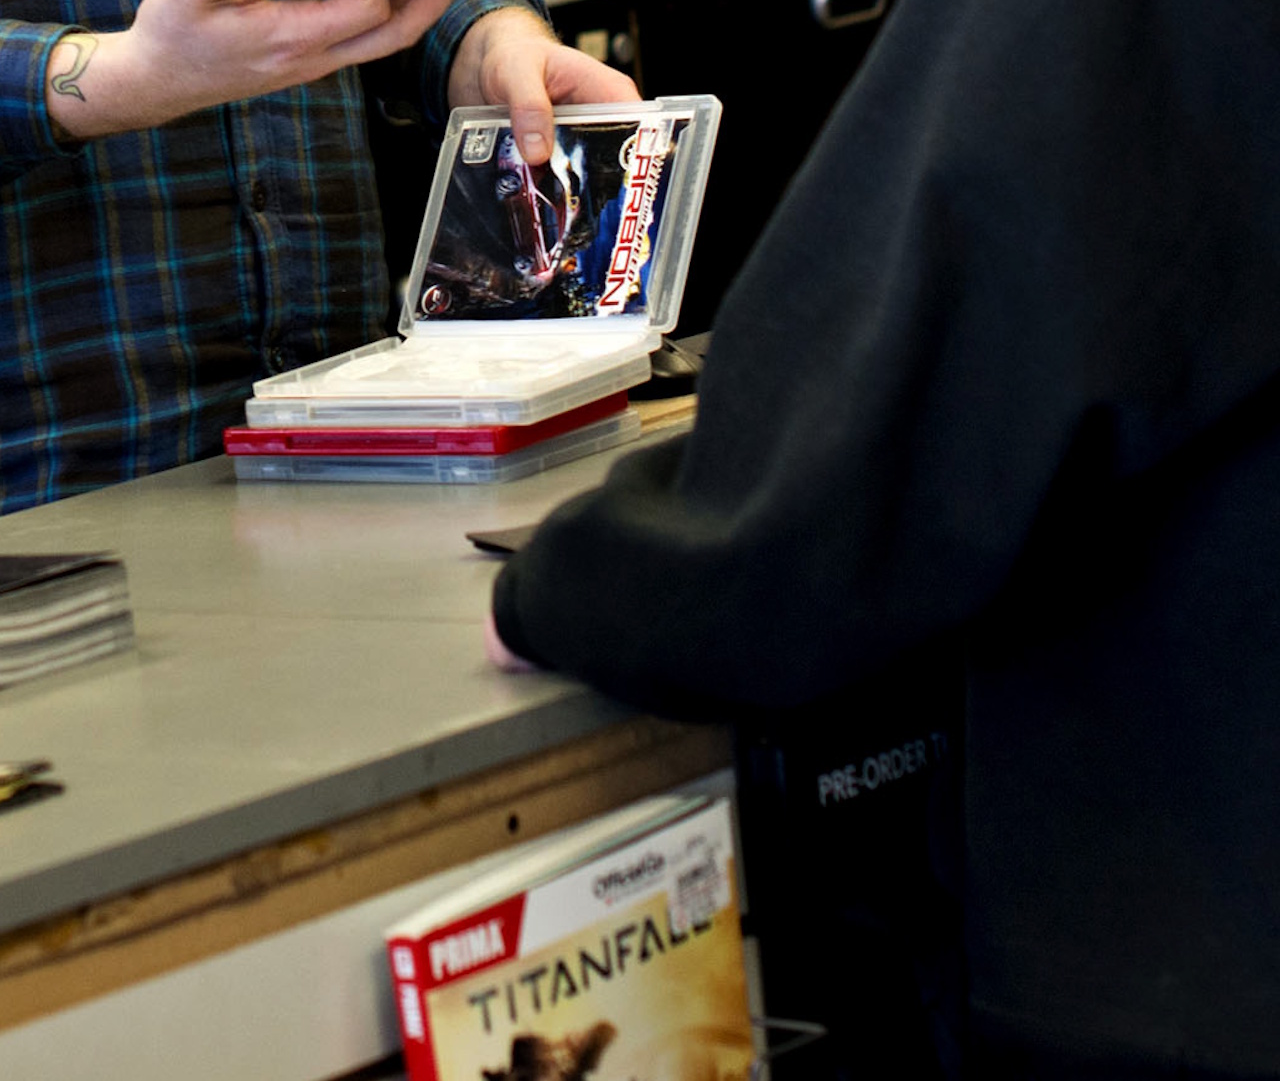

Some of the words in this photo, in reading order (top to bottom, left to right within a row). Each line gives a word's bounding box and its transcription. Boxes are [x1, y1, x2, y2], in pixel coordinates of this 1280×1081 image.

[599, 127, 658, 306] CARBON
[818, 739, 927, 807] PRE-ORDER
[428, 920, 505, 979] PRIMA
